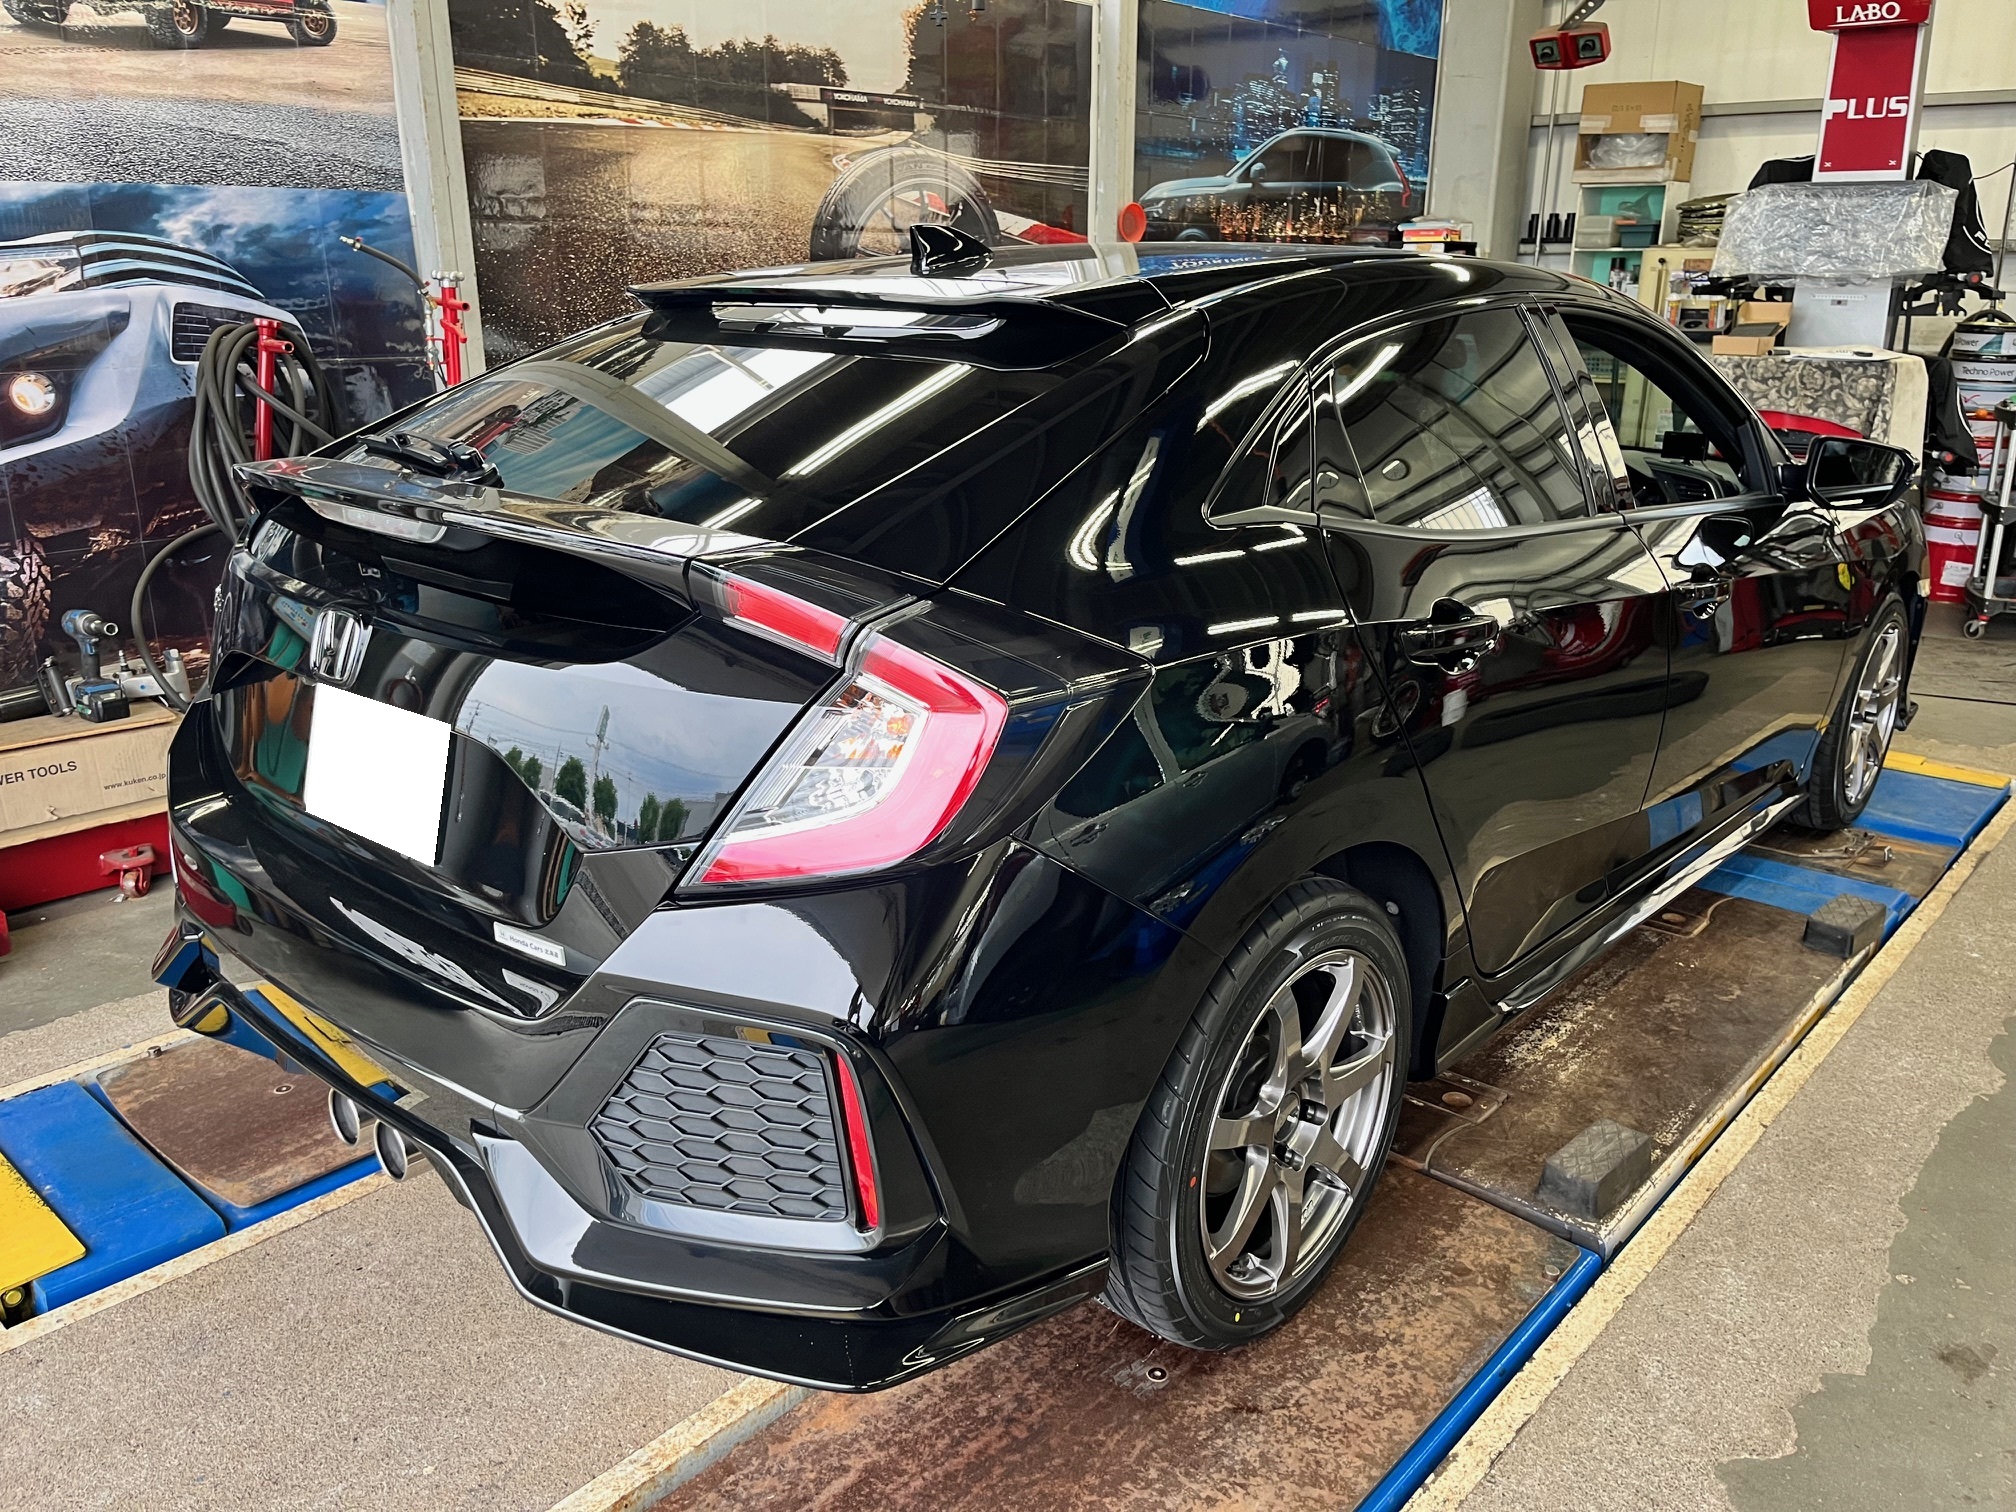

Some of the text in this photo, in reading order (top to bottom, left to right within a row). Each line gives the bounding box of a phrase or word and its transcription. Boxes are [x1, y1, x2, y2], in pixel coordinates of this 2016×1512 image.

[1836, 1, 1901, 23] LABO
[833, 93, 917, 107] YOKOHAMA YOKOHAMA
[1823, 96, 1909, 120] PLUS
[1962, 366, 2014, 377] Techno Power
[27, 760, 77, 779] TOOLS
[103, 772, 166, 791] www.kuken.co.jp
[509, 935, 544, 953] Honda Cars
